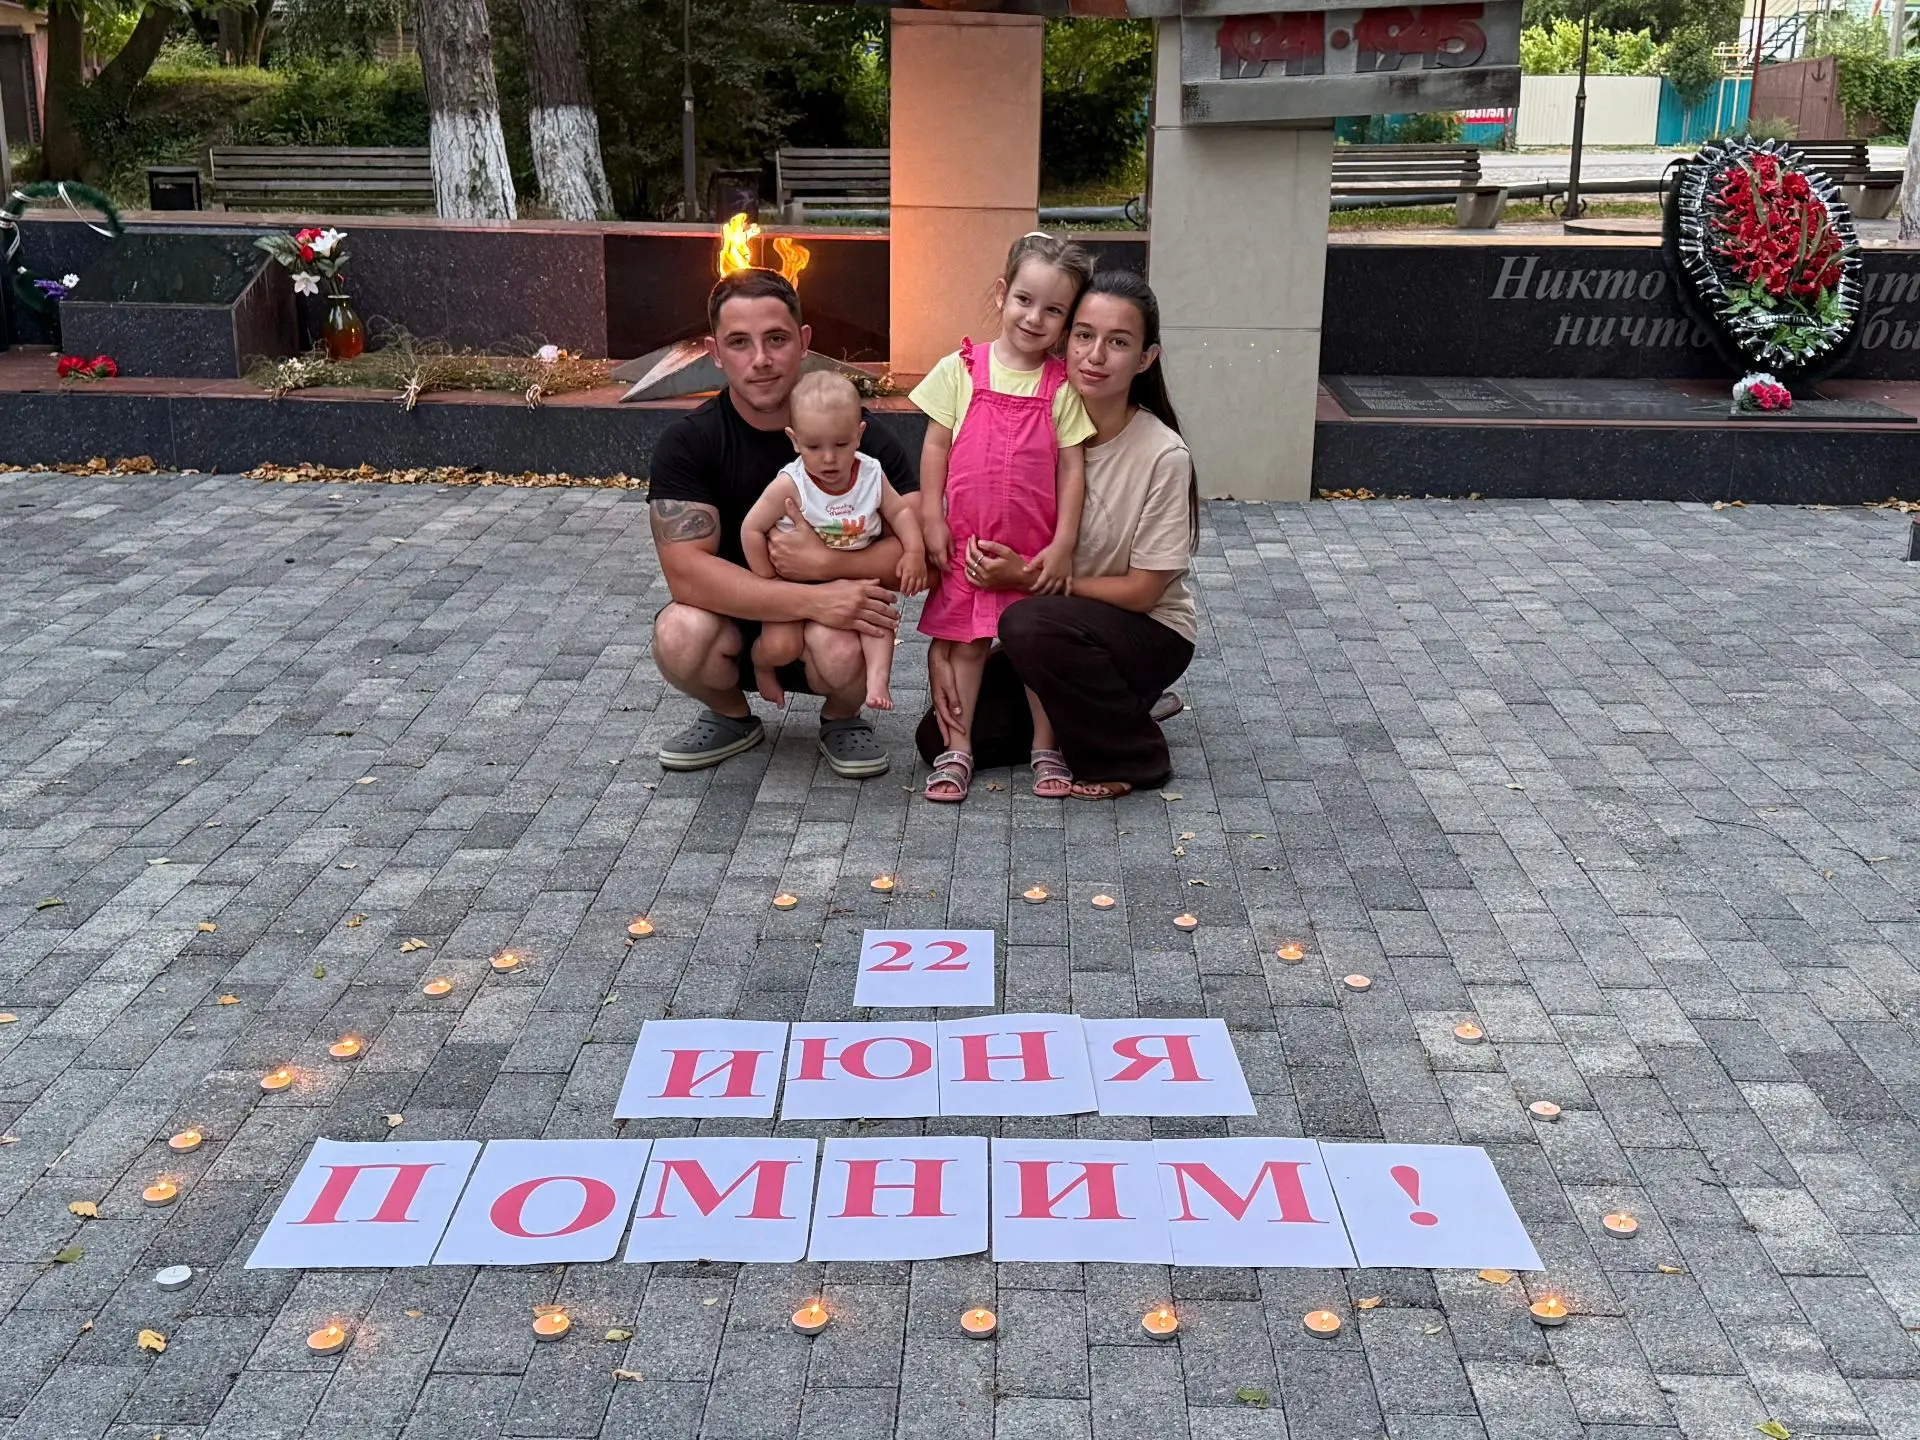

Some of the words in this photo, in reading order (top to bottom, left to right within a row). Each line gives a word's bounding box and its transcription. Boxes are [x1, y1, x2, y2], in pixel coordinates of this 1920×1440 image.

[1487, 254, 1667, 300] Никто
[1553, 313, 1710, 348] ничто
[866, 940, 972, 972] 22
[647, 1030, 1216, 1098] ИЮНЯ
